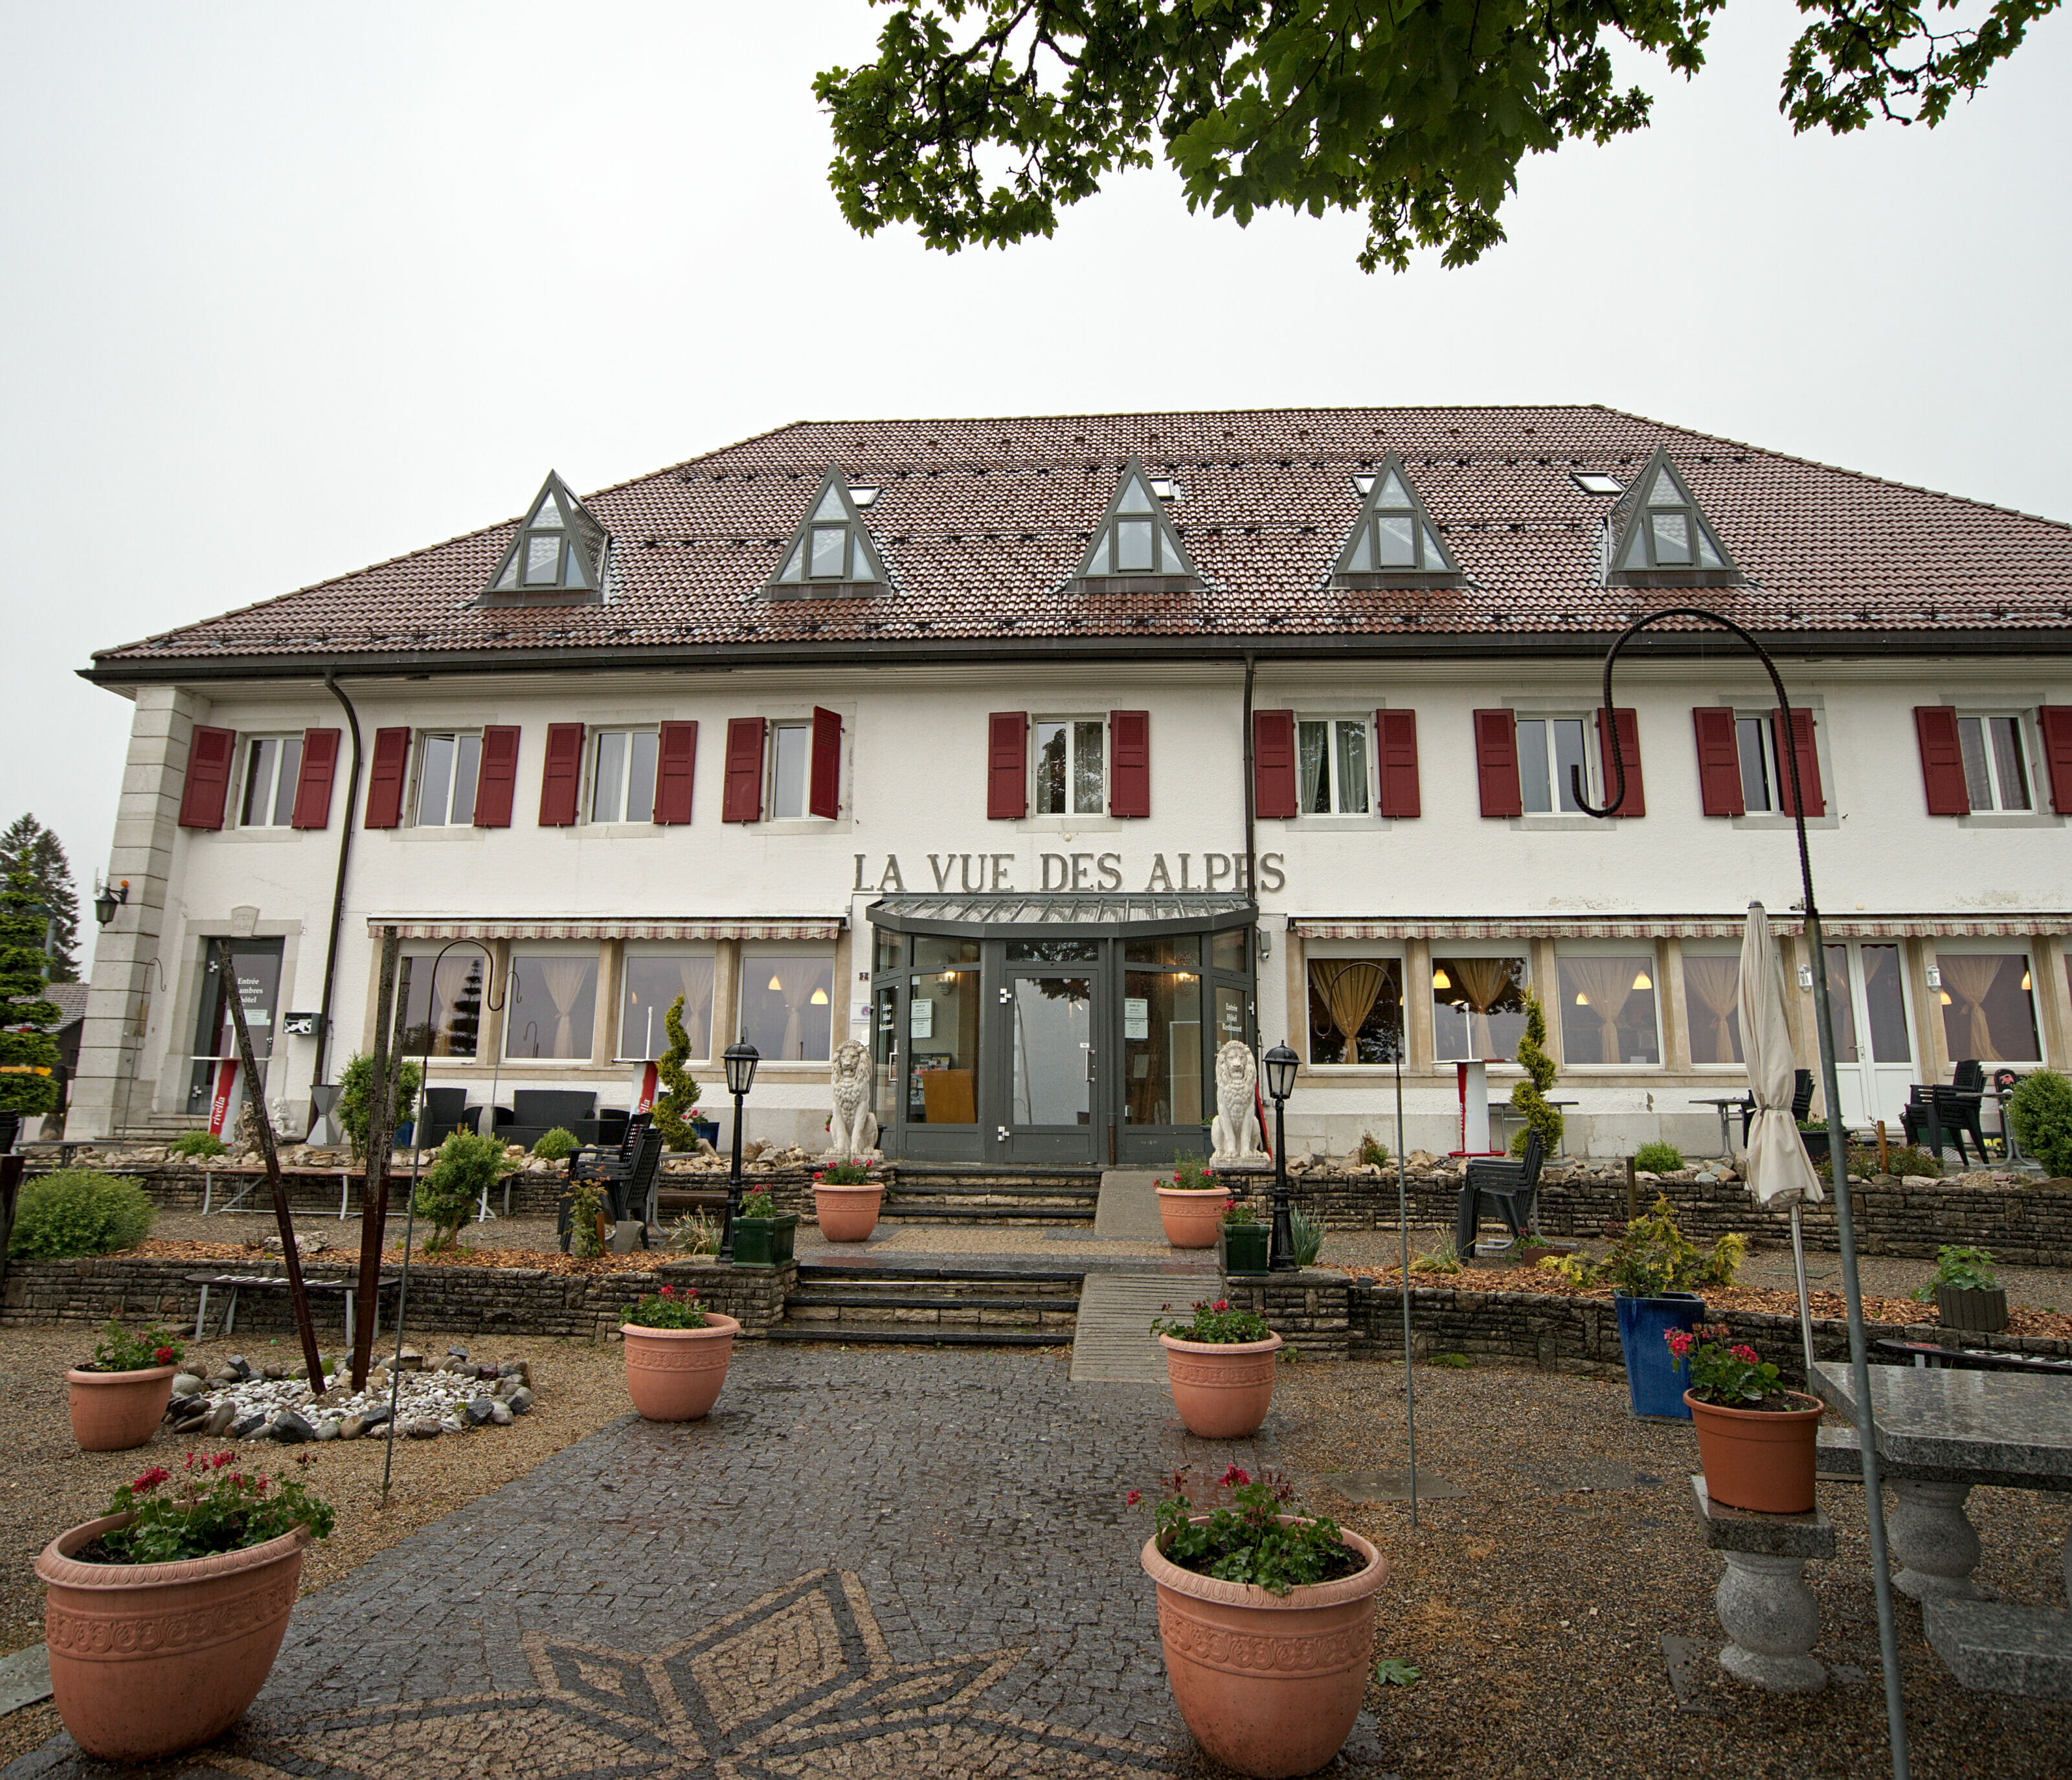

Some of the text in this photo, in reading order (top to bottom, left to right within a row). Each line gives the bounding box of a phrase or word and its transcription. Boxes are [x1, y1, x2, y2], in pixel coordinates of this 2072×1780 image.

[851, 852, 1285, 894] LA VUE DES ALPES
[212, 1096, 225, 1126] rivella
